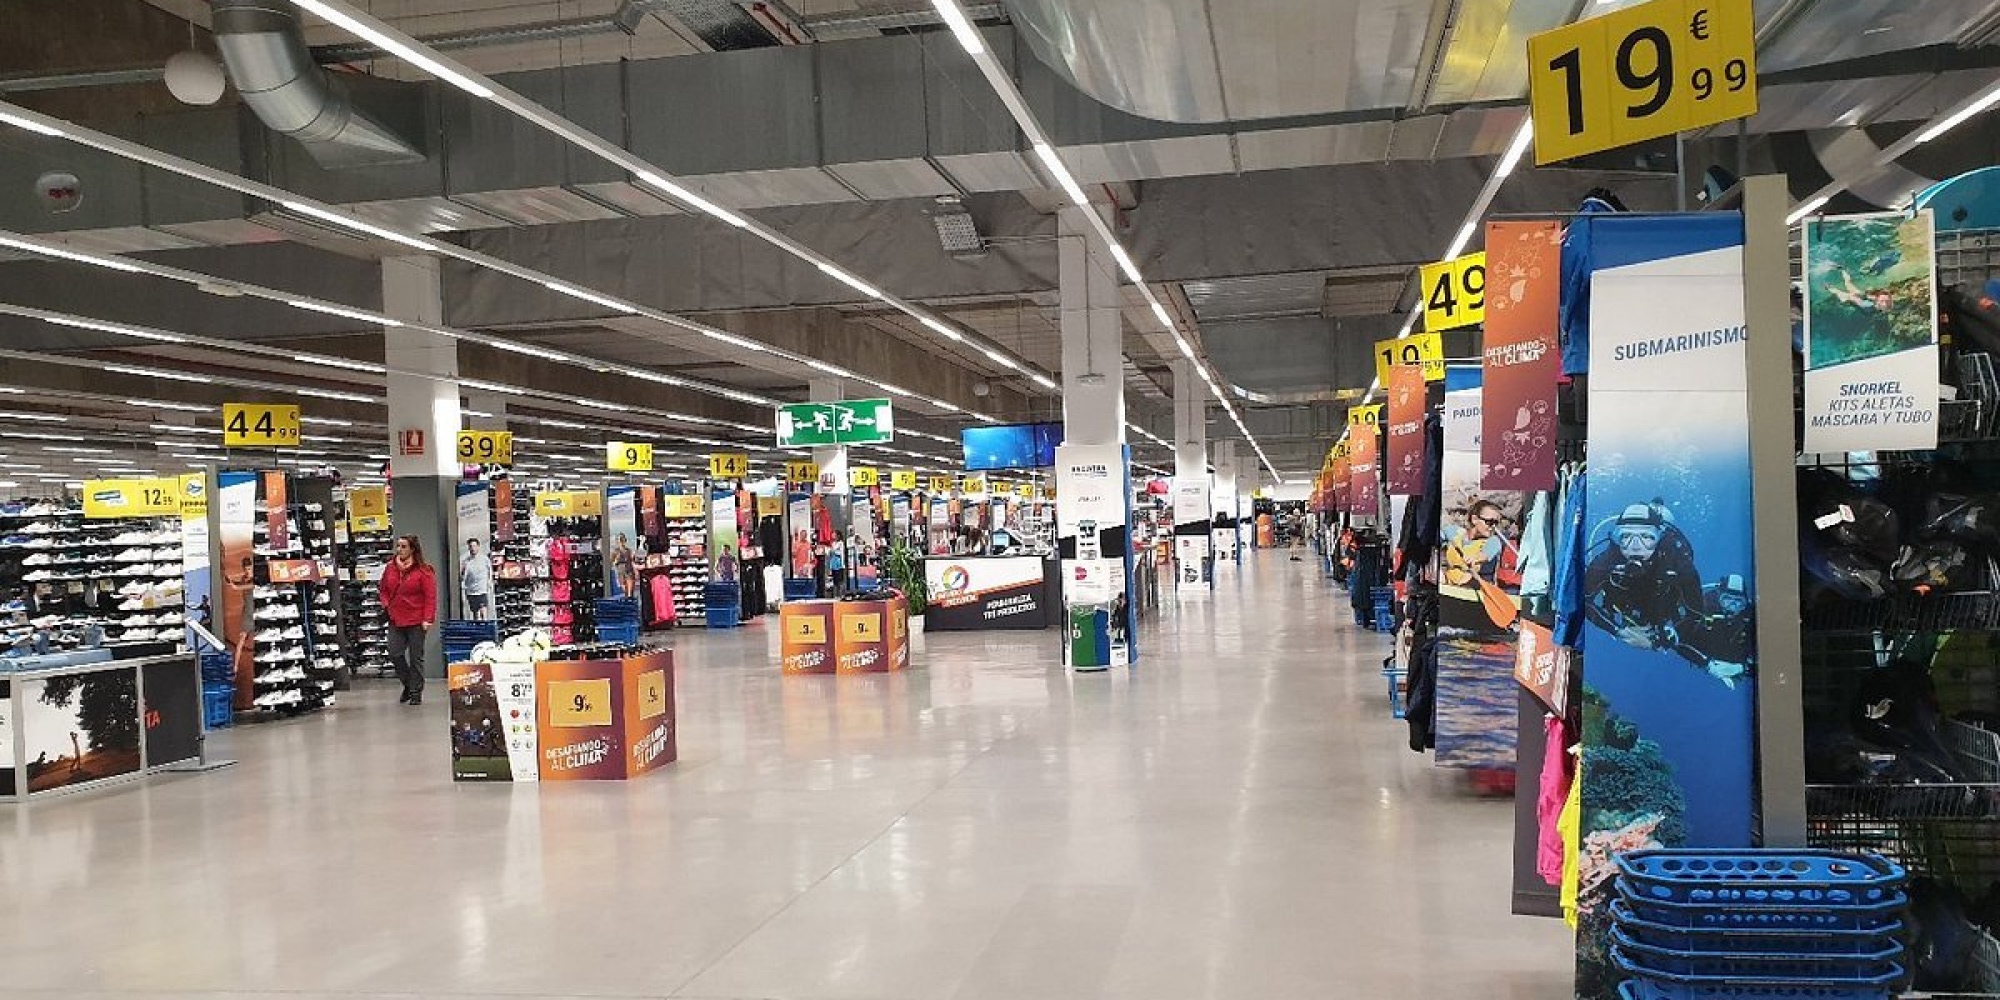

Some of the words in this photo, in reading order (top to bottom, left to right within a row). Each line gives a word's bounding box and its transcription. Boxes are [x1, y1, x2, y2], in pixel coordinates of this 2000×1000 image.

[1549, 26, 1673, 136] 19
[1691, 59, 1747, 101] 99
[1427, 264, 1486, 317] 49
[1839, 380, 1903, 397] SNORKEL
[1452, 406, 1481, 420] PADD
[1828, 398, 1859, 413] KITS
[1860, 395, 1915, 411] ALETAS
[227, 409, 275, 438] 44
[1881, 413, 1893, 425] Y
[1894, 409, 1933, 425] TUBO
[459, 435, 494, 458] 39
